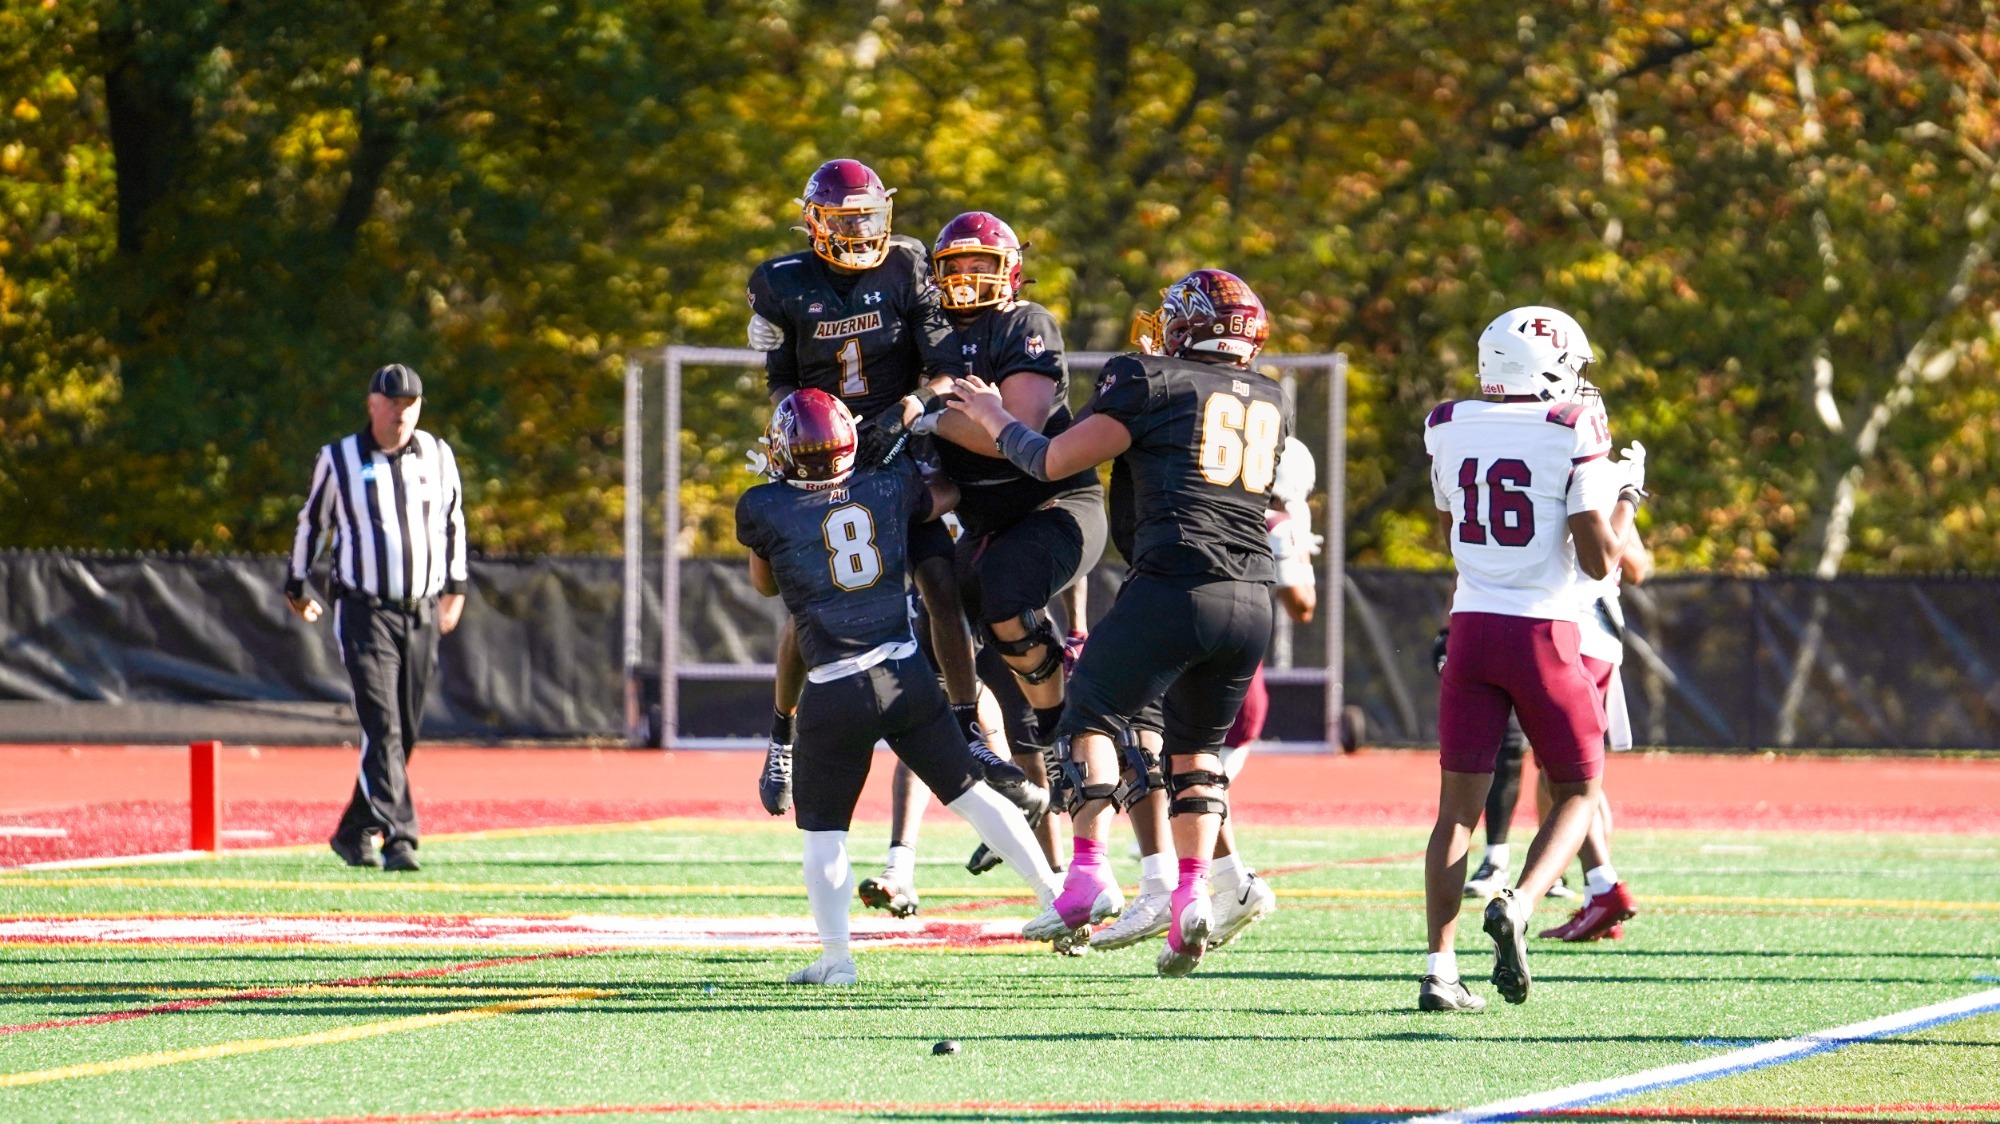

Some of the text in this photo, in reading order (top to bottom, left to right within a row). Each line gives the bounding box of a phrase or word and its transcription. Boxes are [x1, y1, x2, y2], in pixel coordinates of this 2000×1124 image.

[815, 312, 882, 338] ALVERNIA
[835, 337, 869, 398] 1
[1200, 391, 1281, 494] 68
[829, 488, 850, 504] AU
[1458, 457, 1536, 547] 16
[821, 502, 884, 592] 8
